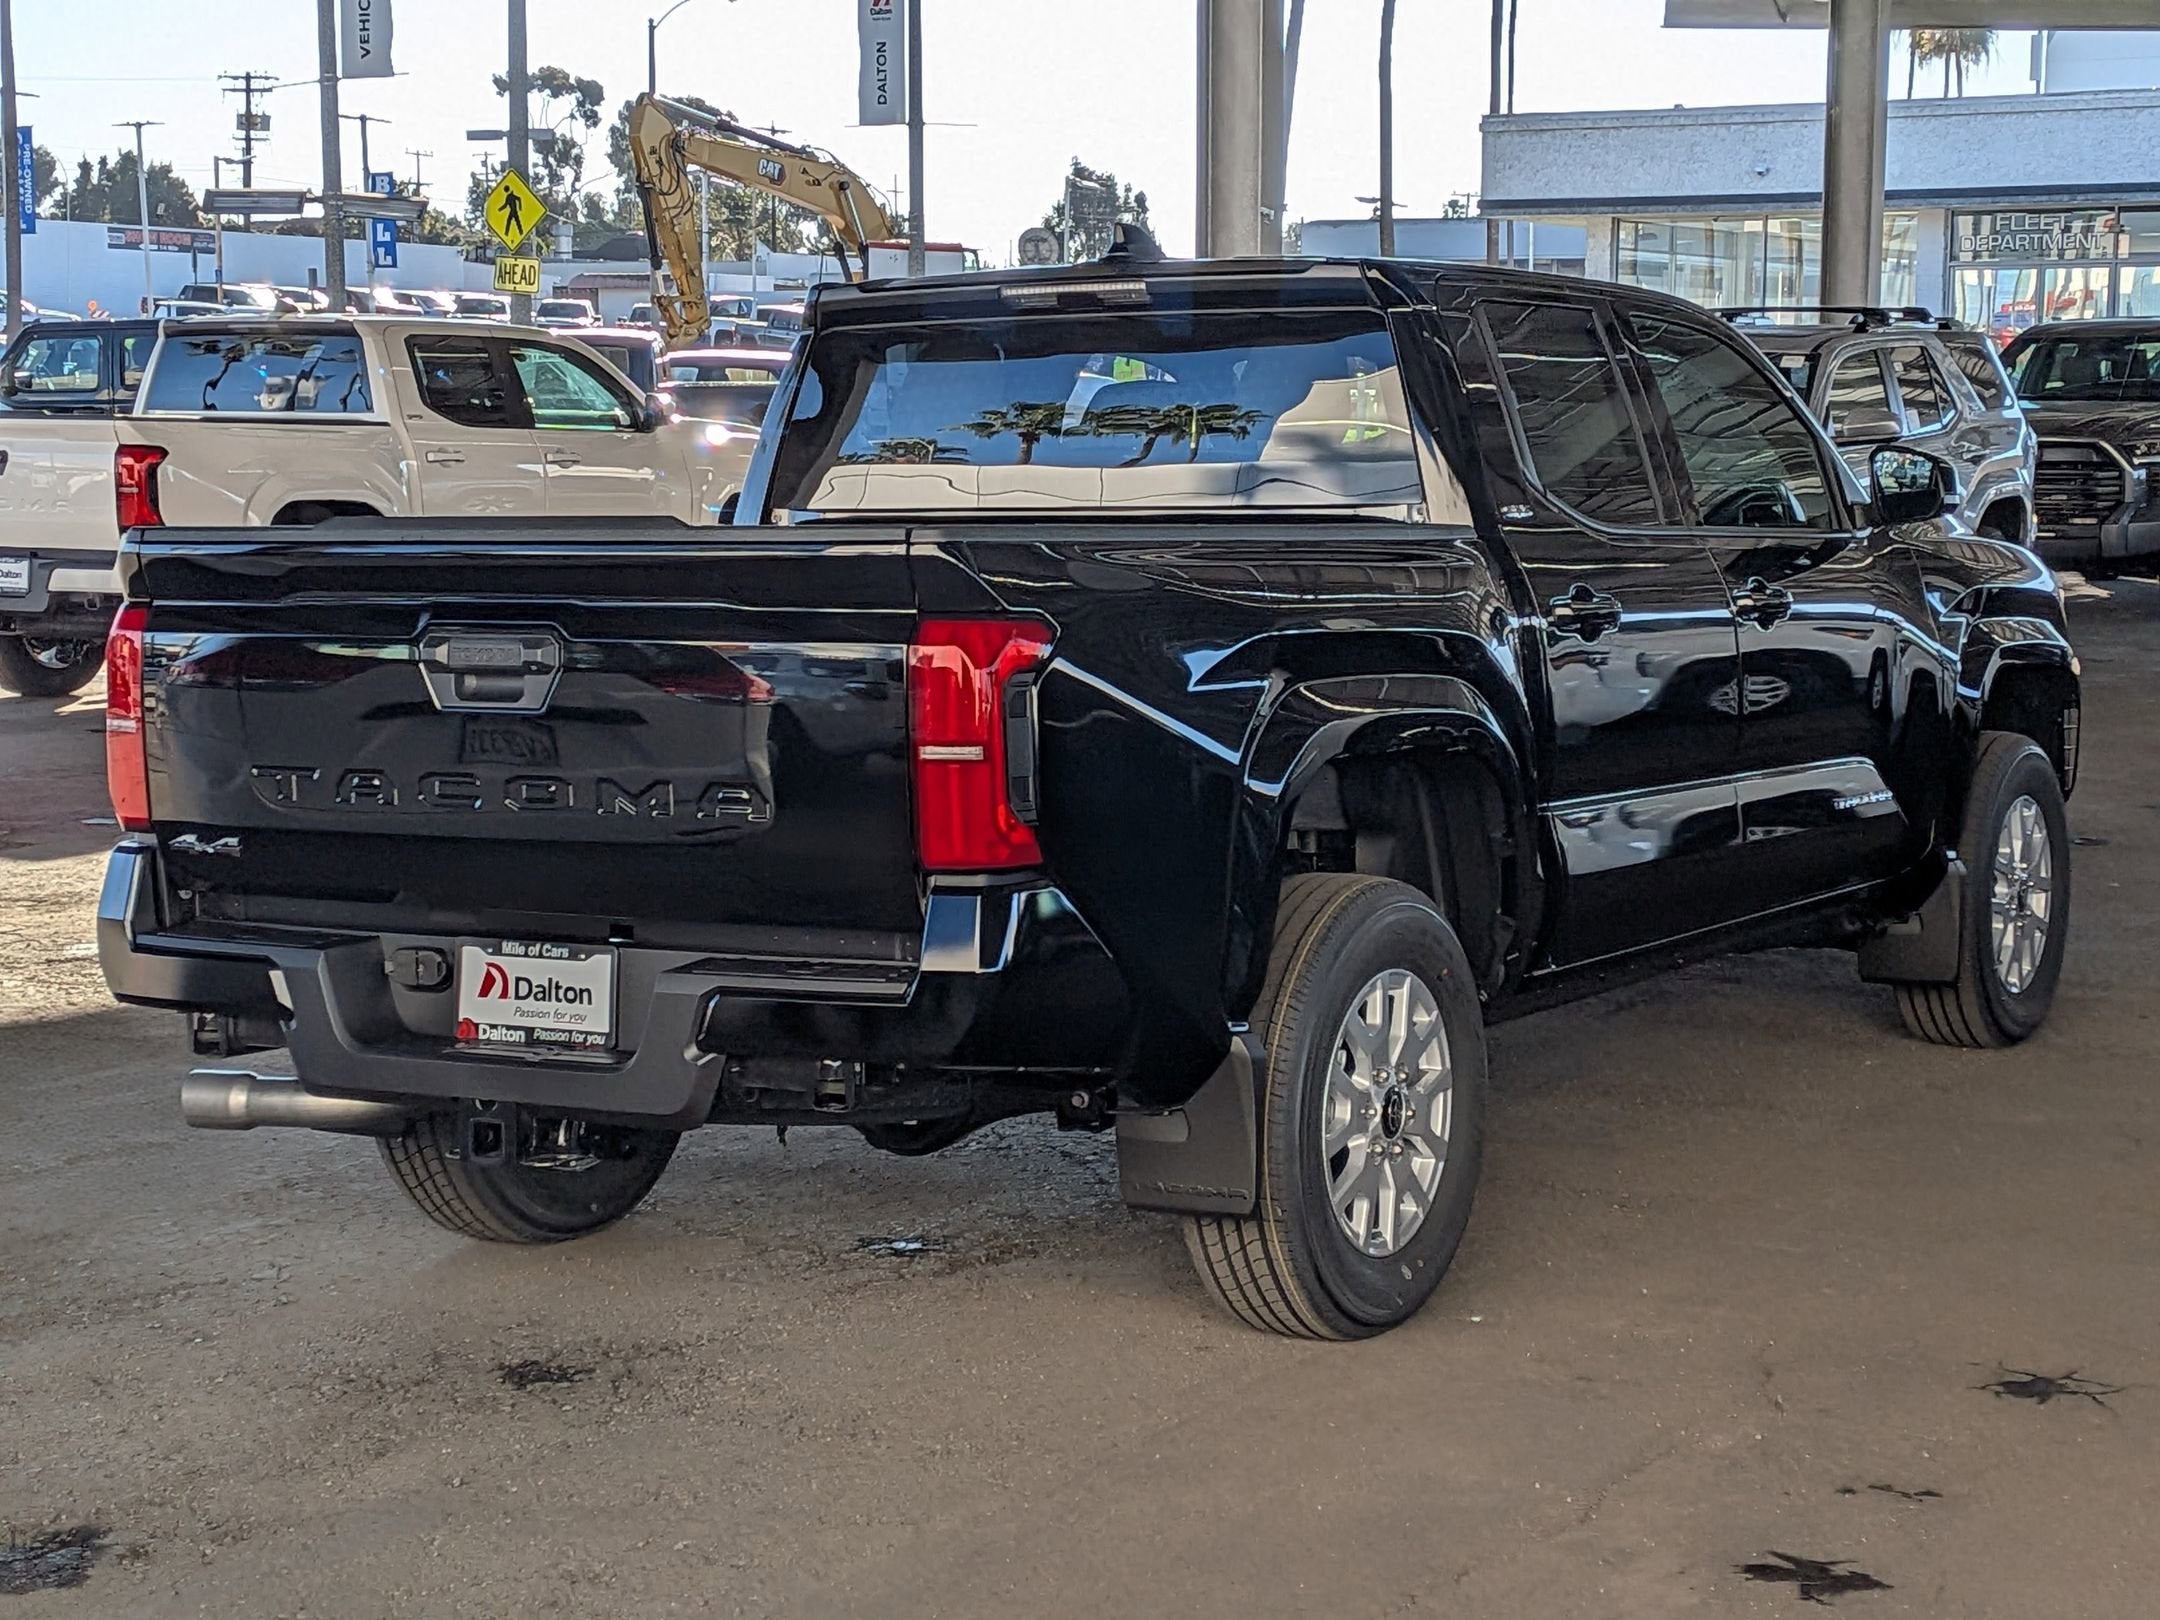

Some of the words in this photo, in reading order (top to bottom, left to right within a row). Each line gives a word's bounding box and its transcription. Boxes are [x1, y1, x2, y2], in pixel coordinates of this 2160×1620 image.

[358, 0, 371, 60] VEHIC
[876, 41, 888, 105] DALTON
[23, 143, 33, 215] PRE-OWNED
[758, 158, 781, 180] CAT
[375, 175, 393, 266] BLL
[1995, 213, 2071, 231] FLEET
[1961, 233, 2104, 251] DEPARTMENT
[496, 262, 537, 286] AHEAD
[250, 765, 772, 822] TACOMA
[501, 941, 525, 956] Mile
[527, 942, 542, 957] of
[542, 944, 570, 959] Cars
[514, 976, 593, 1006] Dalton
[513, 1006, 551, 1019] Passion
[552, 1008, 567, 1022] for
[567, 1012, 588, 1023] you
[478, 1024, 526, 1043] Dalton
[533, 1028, 570, 1043] Passion
[570, 1031, 586, 1044] for
[586, 1034, 606, 1046] you
